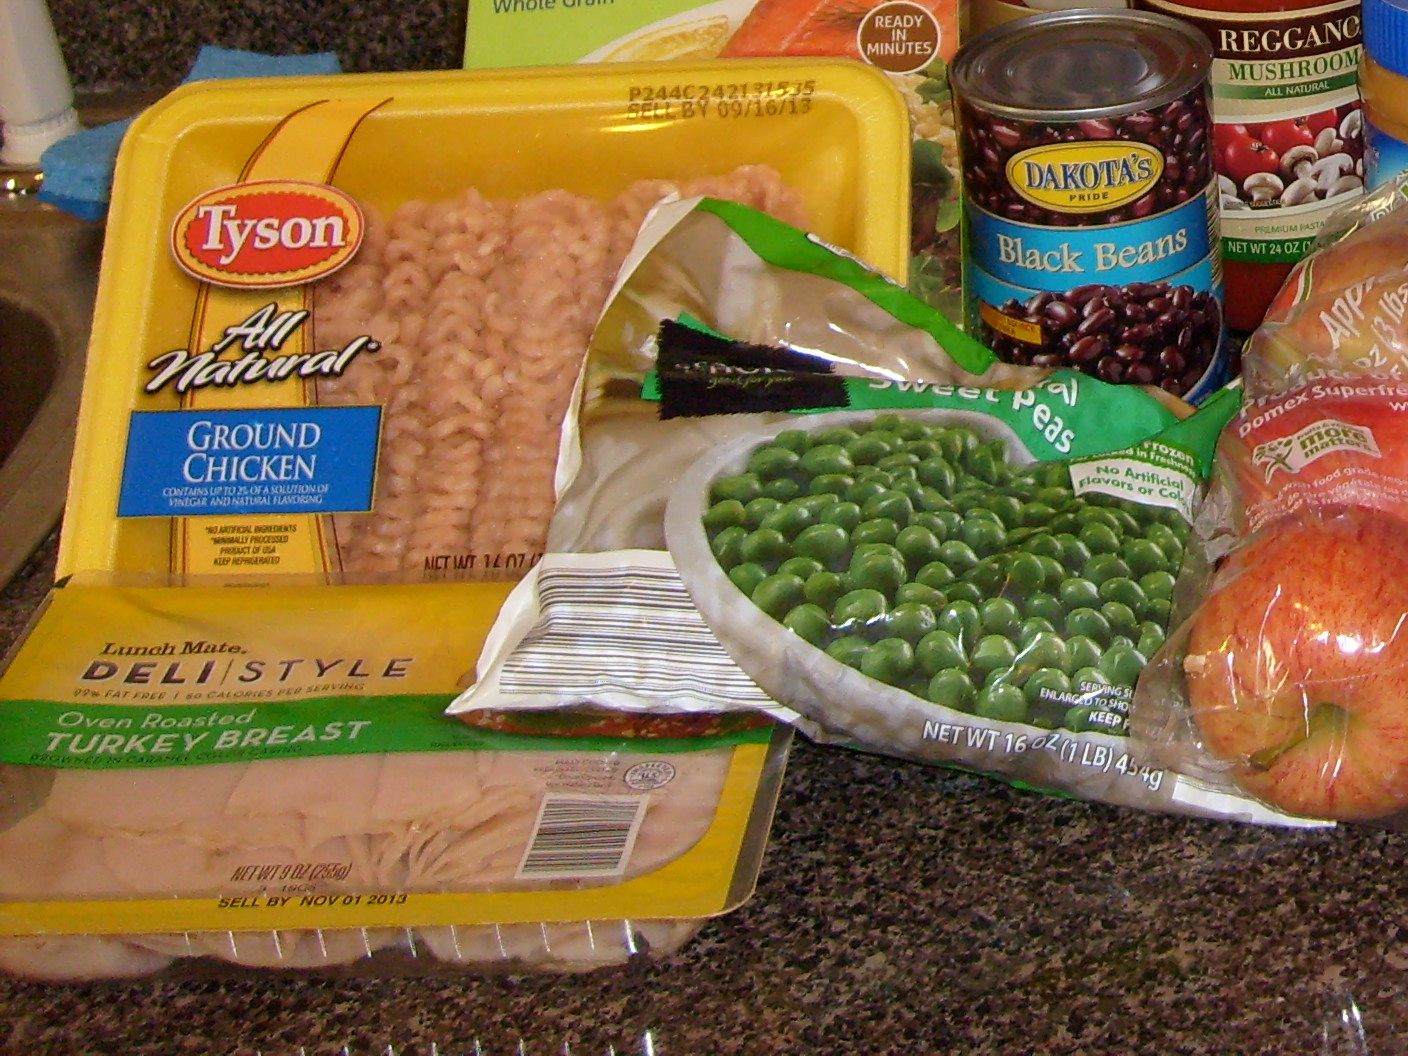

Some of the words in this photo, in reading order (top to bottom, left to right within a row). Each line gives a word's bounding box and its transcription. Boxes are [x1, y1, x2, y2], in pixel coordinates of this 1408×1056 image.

[875, 14, 924, 29] READY
[891, 28, 907, 42] IN
[866, 41, 932, 56] MINUTES
[1229, 47, 1361, 82] MUSHROOM
[1264, 86, 1284, 96] ALL
[1286, 80, 1330, 95] NATURAL
[1022, 152, 1155, 191] DAKOTA'S
[1069, 191, 1110, 202] PRIDE
[198, 203, 346, 265] Tyson
[995, 232, 1084, 273] Black
[1095, 226, 1188, 272] Beans
[1228, 242, 1249, 254] NET
[1250, 243, 1267, 254] WT
[1268, 243, 1282, 255] 24
[1284, 241, 1301, 254] OZ
[214, 302, 310, 352] All
[143, 334, 372, 394] Natural
[1238, 392, 1309, 439] Domex
[187, 420, 321, 451] GROUND
[182, 453, 318, 483] CHICKEN
[1095, 465, 1120, 476] No
[1125, 466, 1185, 491] Artificial
[1078, 476, 1134, 492] Flavors
[1136, 485, 1154, 496] or
[99, 642, 177, 658] Lunch
[81, 658, 216, 686] DELI
[238, 657, 415, 684] STYLE
[56, 711, 134, 730] Oven
[141, 707, 257, 730] Roasted
[1088, 710, 1122, 727] KEEP
[46, 730, 210, 755] TURKEY
[213, 720, 373, 751] BREAST
[922, 719, 965, 745] NET
[966, 728, 1001, 752] WT
[1004, 733, 1027, 755] 16
[1081, 744, 1114, 773] LB)
[218, 896, 260, 908] SELL
[266, 896, 292, 908] BY
[300, 895, 338, 907] NOV
[342, 895, 362, 906] 01
